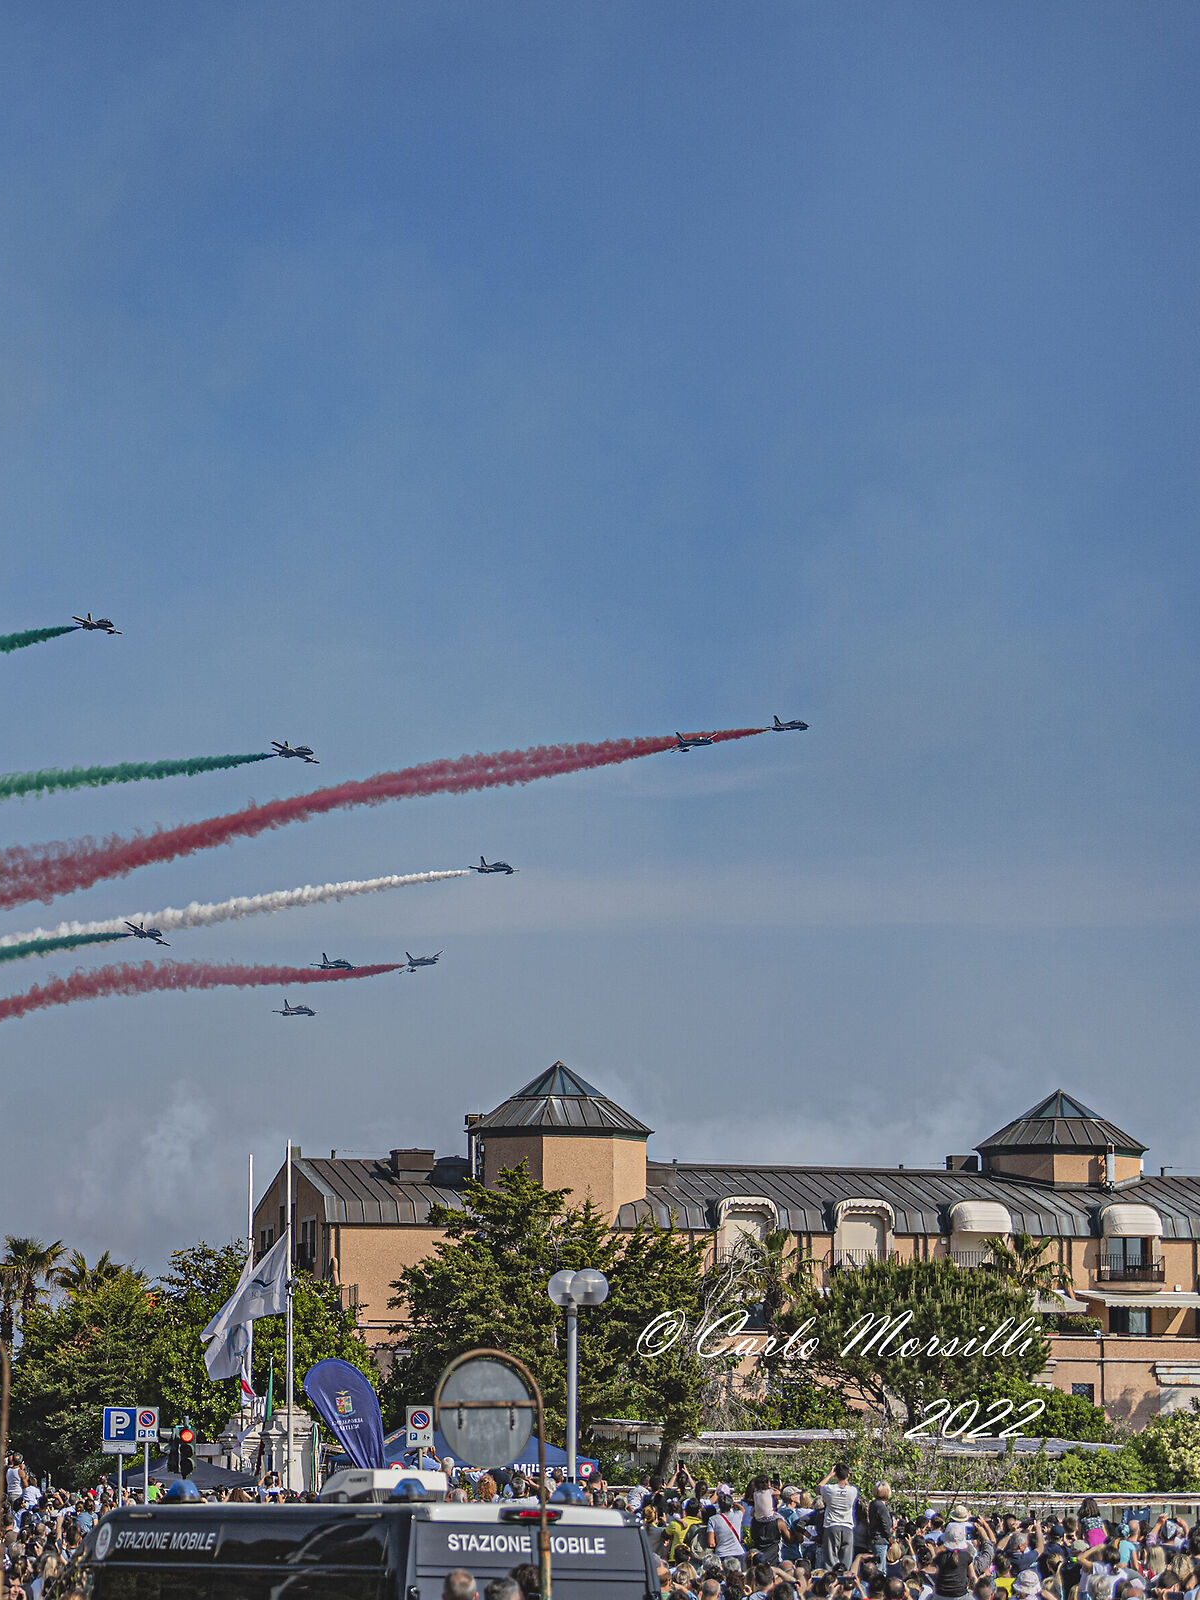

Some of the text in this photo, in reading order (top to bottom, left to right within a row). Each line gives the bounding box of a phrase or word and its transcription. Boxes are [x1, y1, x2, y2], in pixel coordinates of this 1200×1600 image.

[110, 1411, 131, 1438] P
[513, 1463, 568, 1477] Miliae
[115, 1530, 216, 1551] STAZIONE MOBILE
[447, 1533, 531, 1553] STAZIONE
